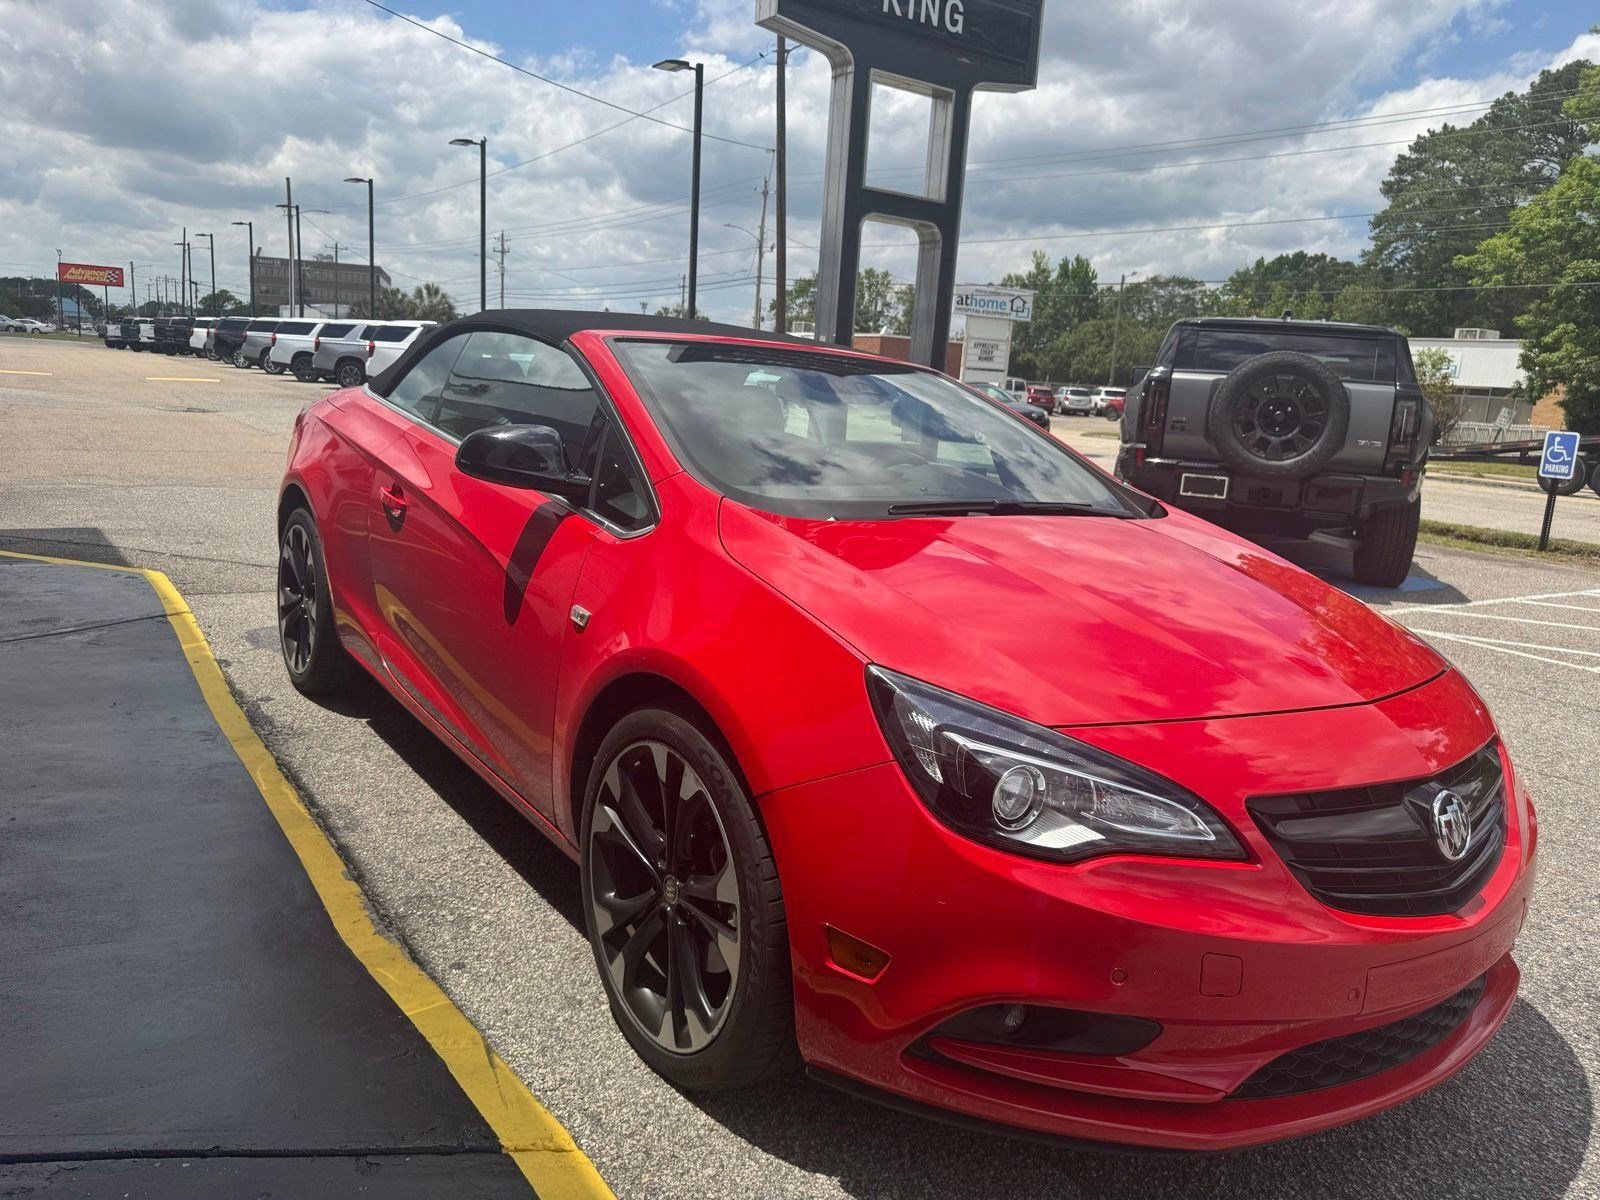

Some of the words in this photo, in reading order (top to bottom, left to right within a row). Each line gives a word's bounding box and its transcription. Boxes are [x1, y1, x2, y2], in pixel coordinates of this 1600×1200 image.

[63, 272, 83, 280] Auto
[83, 274, 105, 282] Parts
[67, 267, 105, 277] Advance
[956, 293, 1007, 310] athome
[955, 306, 981, 314] HOSPITAL
[982, 309, 1012, 317] EQUIPMENT
[973, 342, 1000, 351] APPRECIATE
[980, 348, 994, 356] EVERY
[1544, 463, 1569, 474] PARKING
